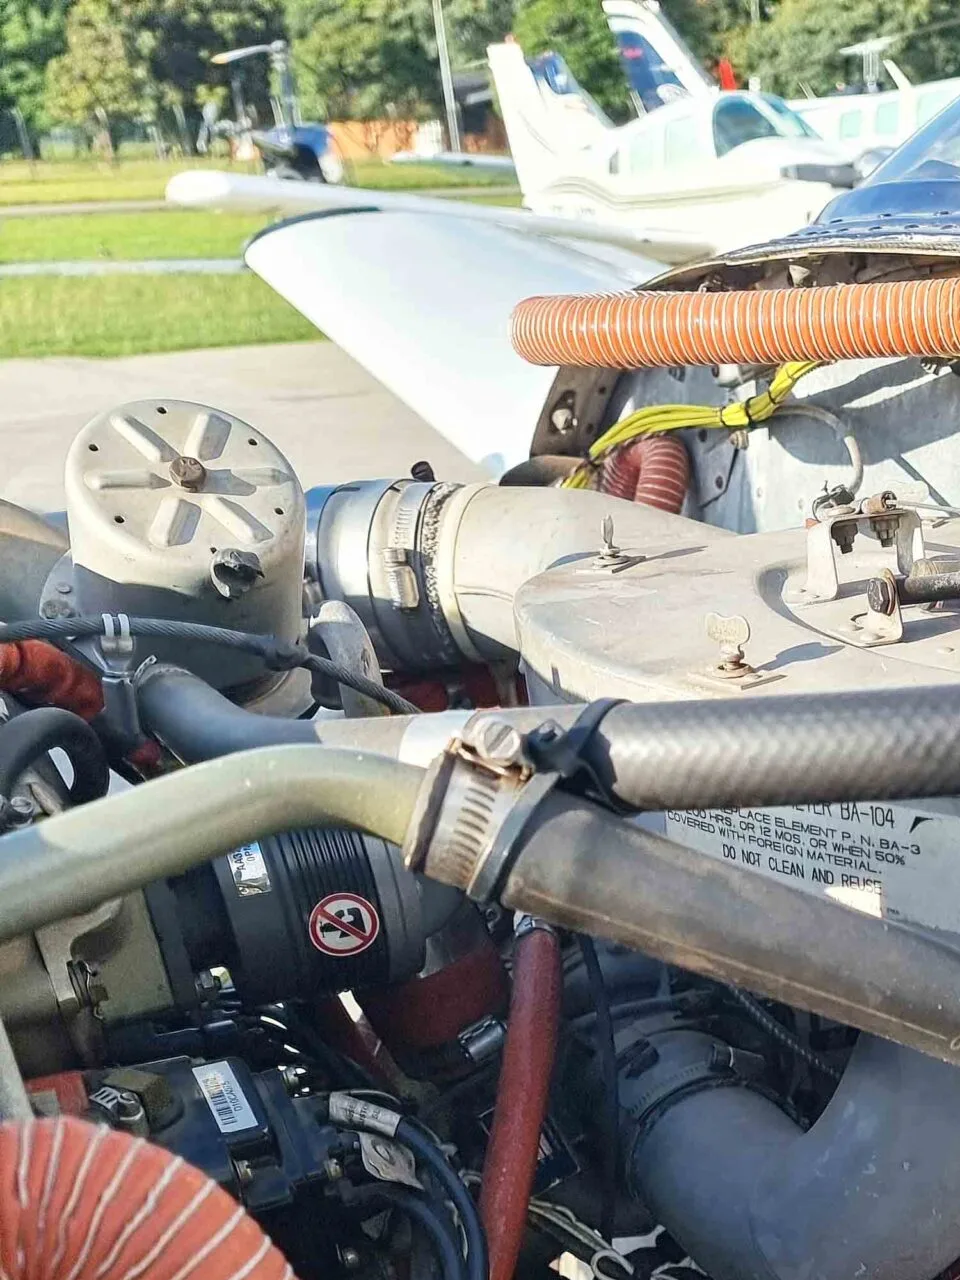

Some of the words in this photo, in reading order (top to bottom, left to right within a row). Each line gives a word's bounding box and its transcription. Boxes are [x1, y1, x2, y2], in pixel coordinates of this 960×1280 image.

[709, 812, 736, 829] HRS.
[739, 820, 756, 834] OR
[760, 825, 772, 838] 12
[774, 831, 805, 846] MOS.
[809, 837, 828, 850] OR
[832, 842, 871, 859] WHEN
[874, 850, 906, 866] 50%
[774, 816, 838, 839] ELEMENT
[879, 838, 921, 855] BA-3
[840, 800, 896, 829] BA-104
[667, 809, 716, 834] COVERED
[718, 826, 746, 843] WITH
[748, 834, 804, 858] FOREIGN
[806, 849, 882, 874] MATERIAL.
[722, 843, 737, 860] DO
[741, 849, 762, 867] NOT
[768, 856, 805, 880] CLEAN
[811, 867, 835, 885] AND
[841, 873, 882, 896] REUSE
